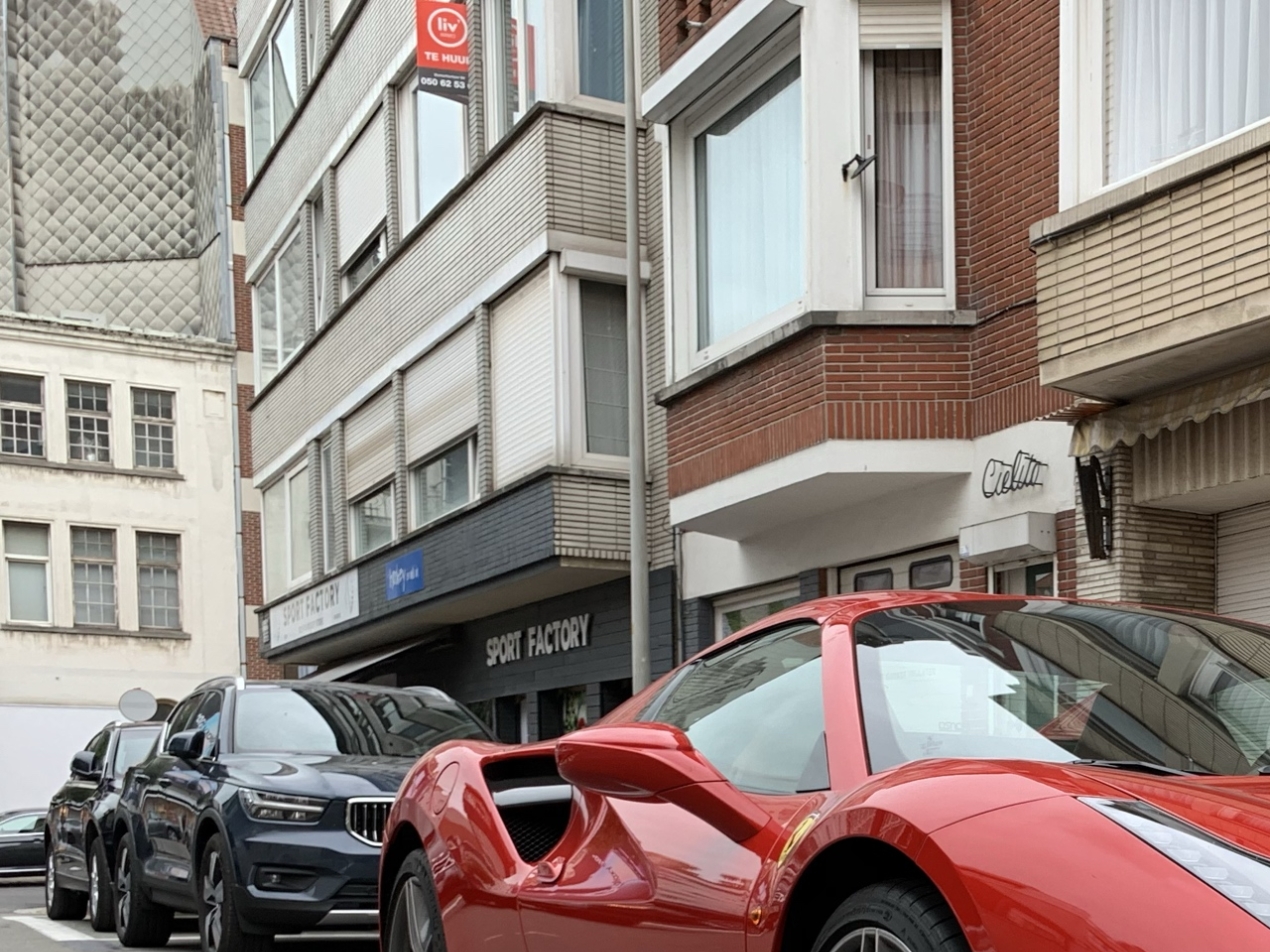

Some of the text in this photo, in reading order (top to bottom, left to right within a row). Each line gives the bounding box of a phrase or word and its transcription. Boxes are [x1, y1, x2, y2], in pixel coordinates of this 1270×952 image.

[424, 51, 469, 65] TE HUU
[420, 77, 466, 90] 050 62 53
[283, 598, 304, 626] SPORT
[306, 581, 340, 617] FACTORY
[486, 613, 589, 667] SPORT FACTORY
